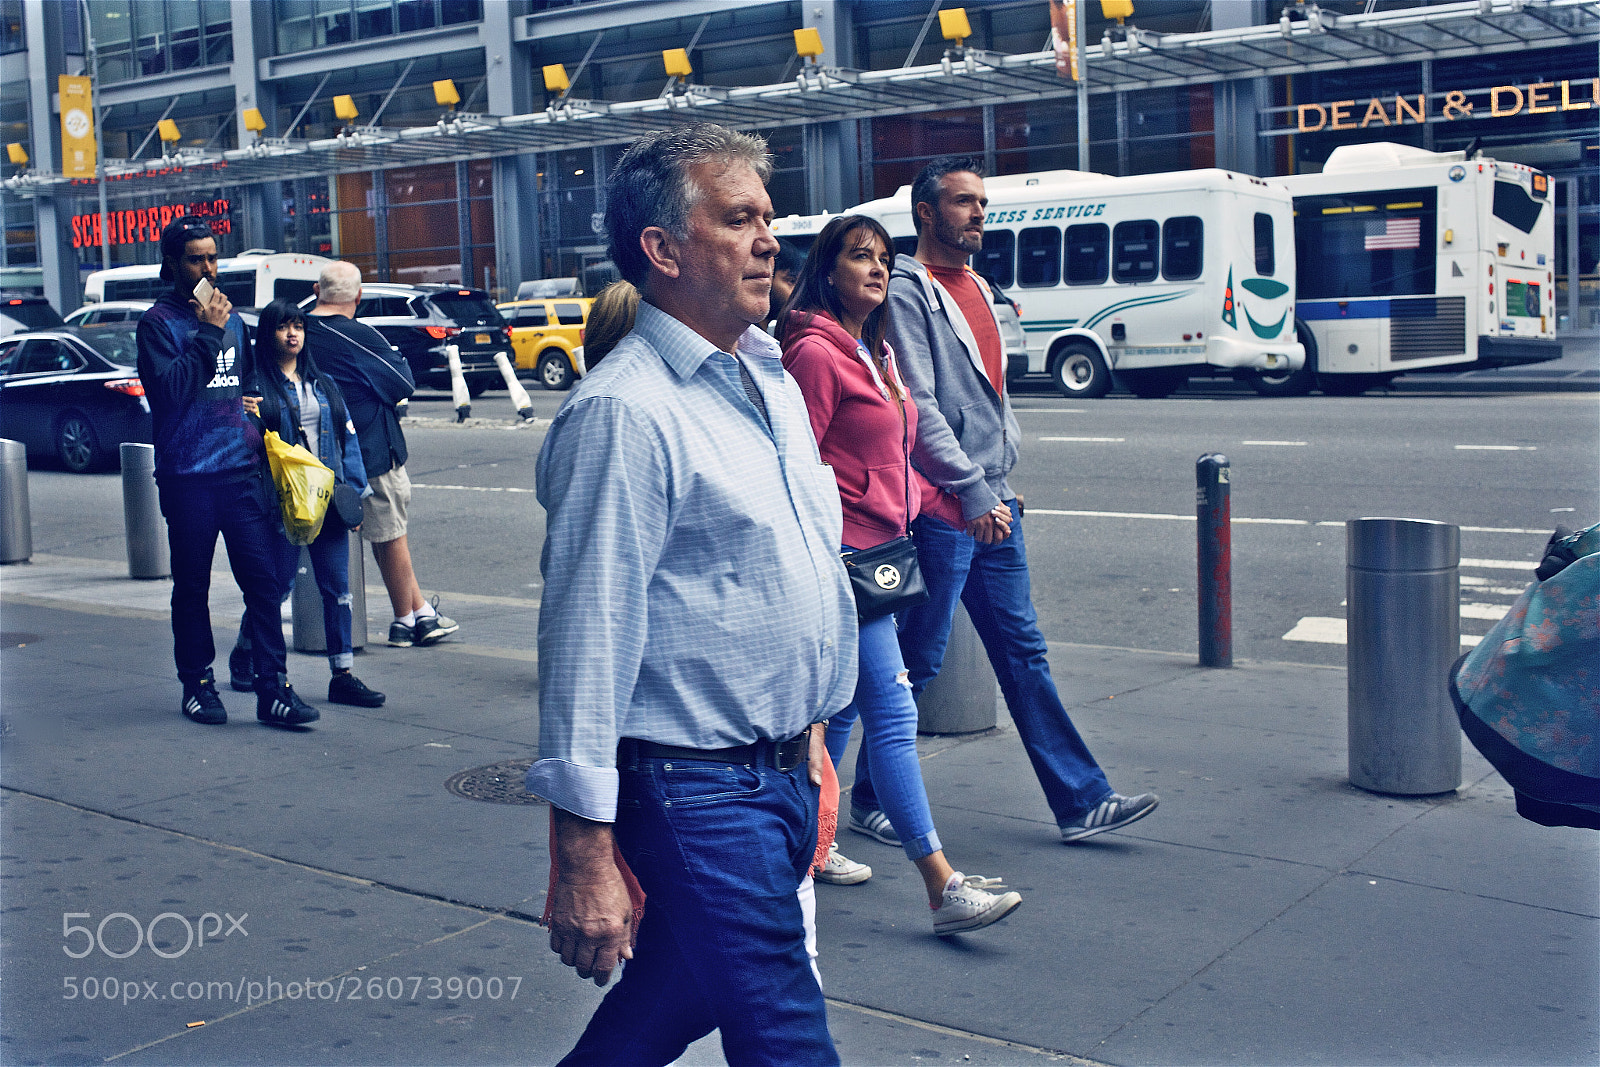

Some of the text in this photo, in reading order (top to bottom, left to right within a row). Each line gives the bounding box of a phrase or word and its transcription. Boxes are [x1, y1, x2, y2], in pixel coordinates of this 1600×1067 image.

[1298, 77, 1600, 133] DEAN & DEL
[985, 203, 1106, 224] RESS SERVICE
